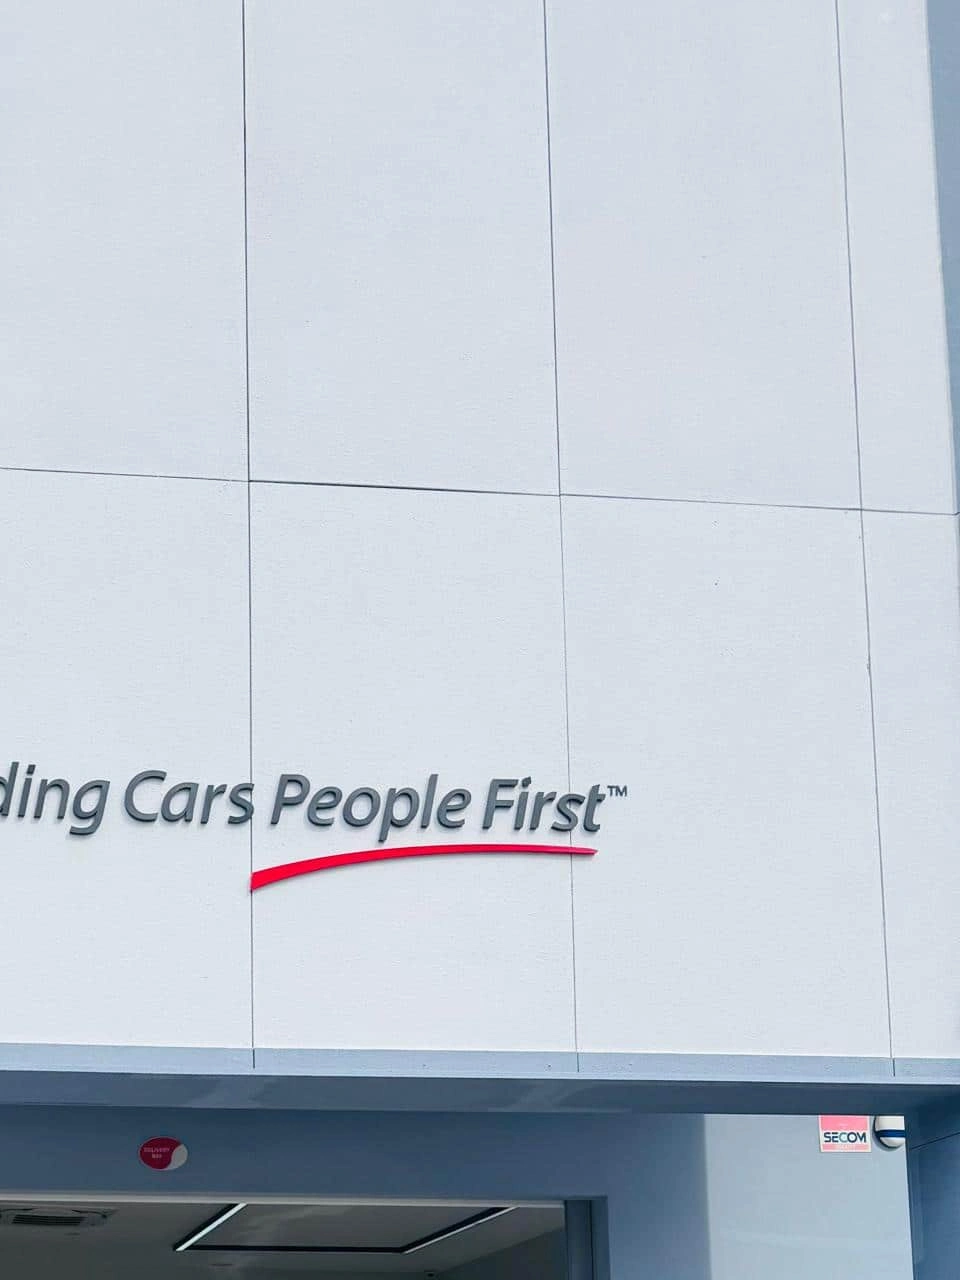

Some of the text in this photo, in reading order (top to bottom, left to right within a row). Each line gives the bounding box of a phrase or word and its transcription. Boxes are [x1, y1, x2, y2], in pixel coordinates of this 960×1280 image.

[123, 769, 255, 824] Cars
[270, 773, 472, 842] People
[823, 1131, 867, 1143] SECOM
